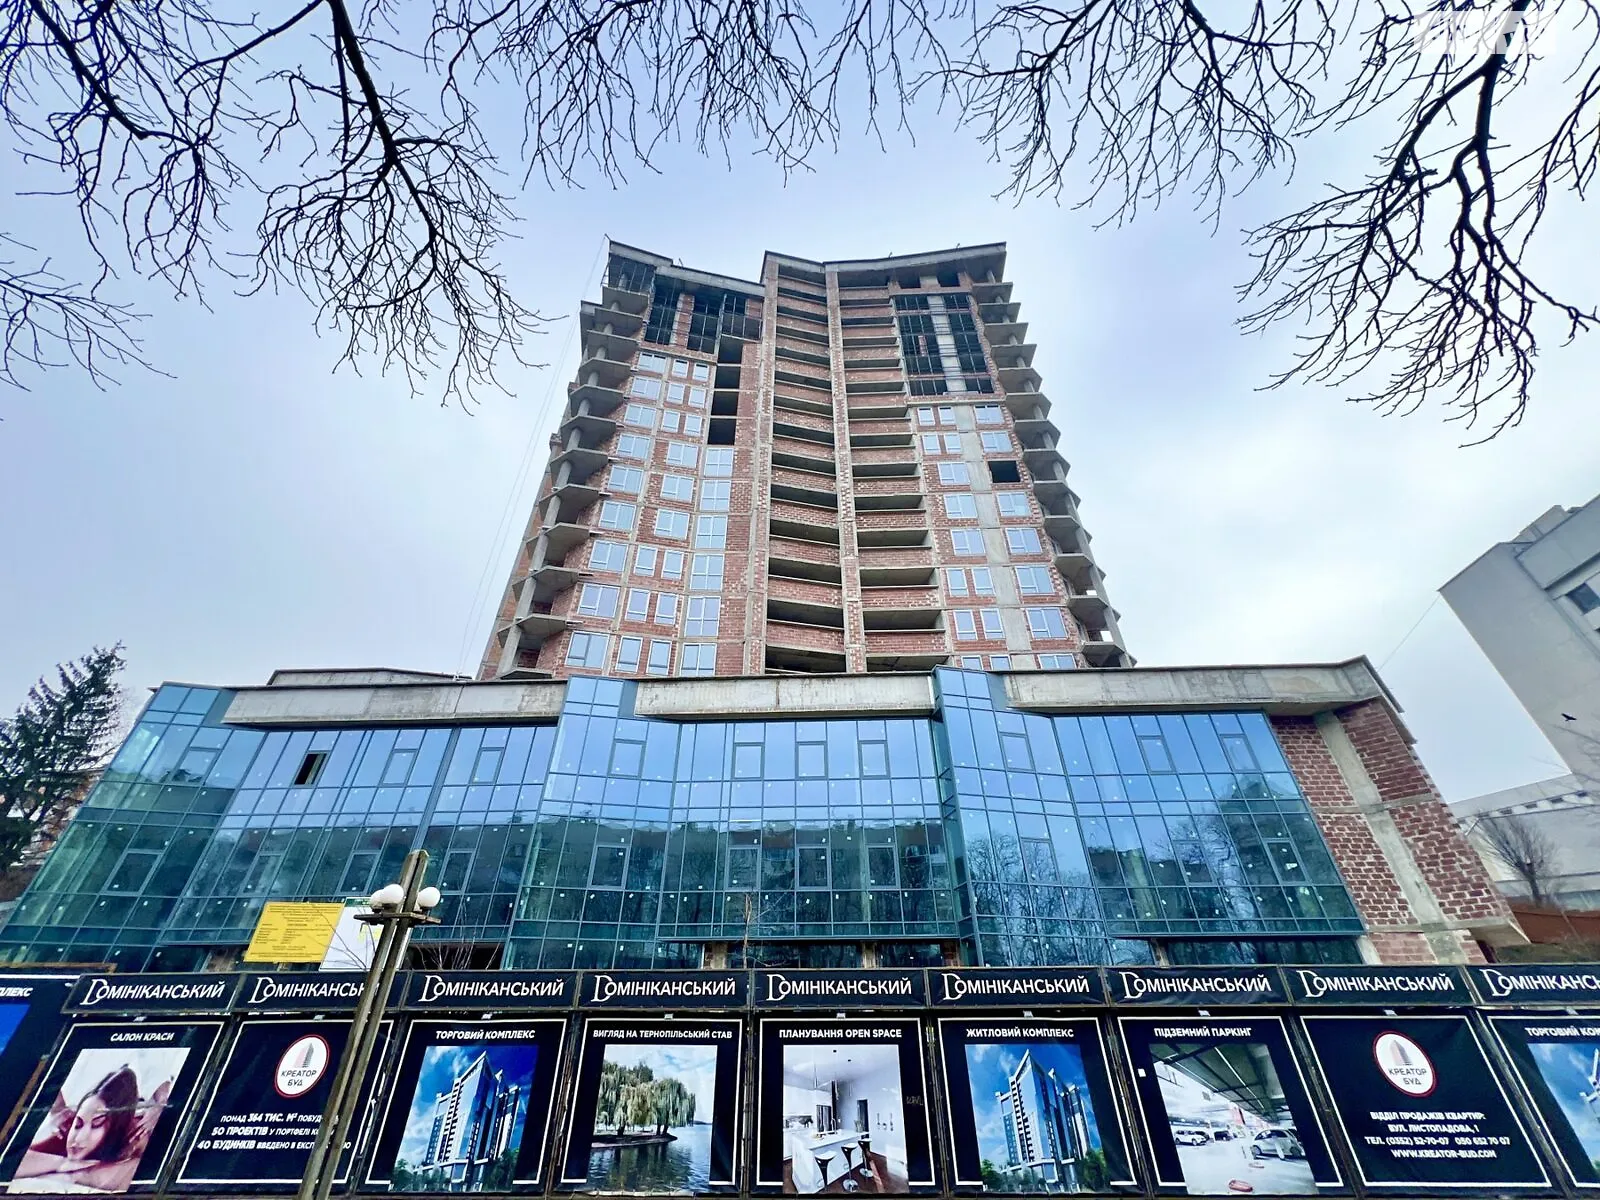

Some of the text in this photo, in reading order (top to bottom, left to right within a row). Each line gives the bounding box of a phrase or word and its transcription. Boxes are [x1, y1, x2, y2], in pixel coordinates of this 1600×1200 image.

[435, 1028, 536, 1040] ТОРГОВИЙ КОМПЛЕКС
[592, 1028, 733, 1040] ВИГЛЯД НА ТЕРНОПІЛЬСЬКИЙ СТАВ
[778, 1028, 902, 1039] ПЛАНУВАННЯ OPEN SPACE
[966, 1026, 1075, 1039] ЖИТЛОВИЙ КОМПЛЕКС
[1153, 1025, 1252, 1038] ПІДЗЕМНИЙ ПАРКІНГ
[1524, 1025, 1580, 1037] ТОРГОВИЙ
[110, 1032, 175, 1042] САЛОН КРАСИ
[280, 1069, 318, 1078] КРЕАТОР
[1388, 1067, 1427, 1076] КРЕАТОР
[287, 1079, 304, 1087] БУД
[1402, 1077, 1422, 1086] БУД
[220, 1114, 247, 1123] ПОНАД
[264, 1113, 284, 1122] ТИС.
[211, 1126, 226, 1136] 50
[269, 1128, 276, 1136] У
[275, 1128, 311, 1136] ПОРТФЕЛІ
[197, 1140, 212, 1149] 40
[212, 1140, 256, 1150] БУДИНКІВ
[256, 1141, 290, 1150] ВВЕДЕНО
[290, 1141, 297, 1149] В
